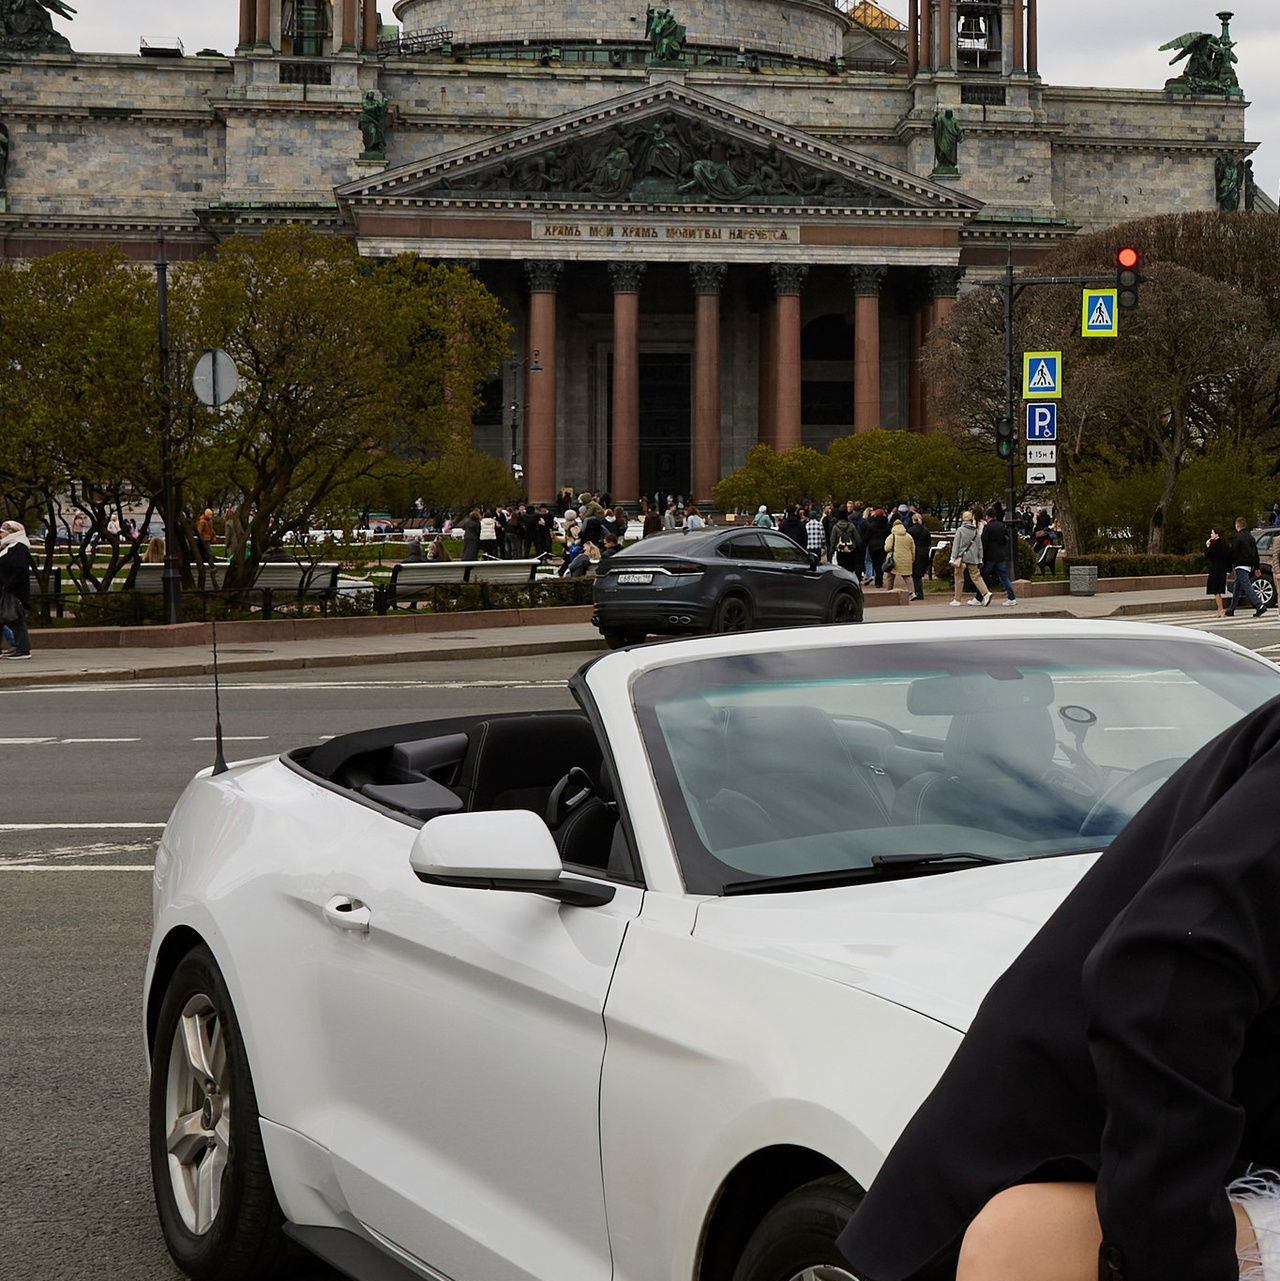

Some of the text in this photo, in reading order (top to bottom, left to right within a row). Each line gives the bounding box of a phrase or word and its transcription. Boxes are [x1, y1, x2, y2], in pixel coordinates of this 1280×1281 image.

[544, 225, 581, 237] ХРАМЪ
[621, 227, 658, 238] ХРАМЪ
[1034, 407, 1051, 436] P
